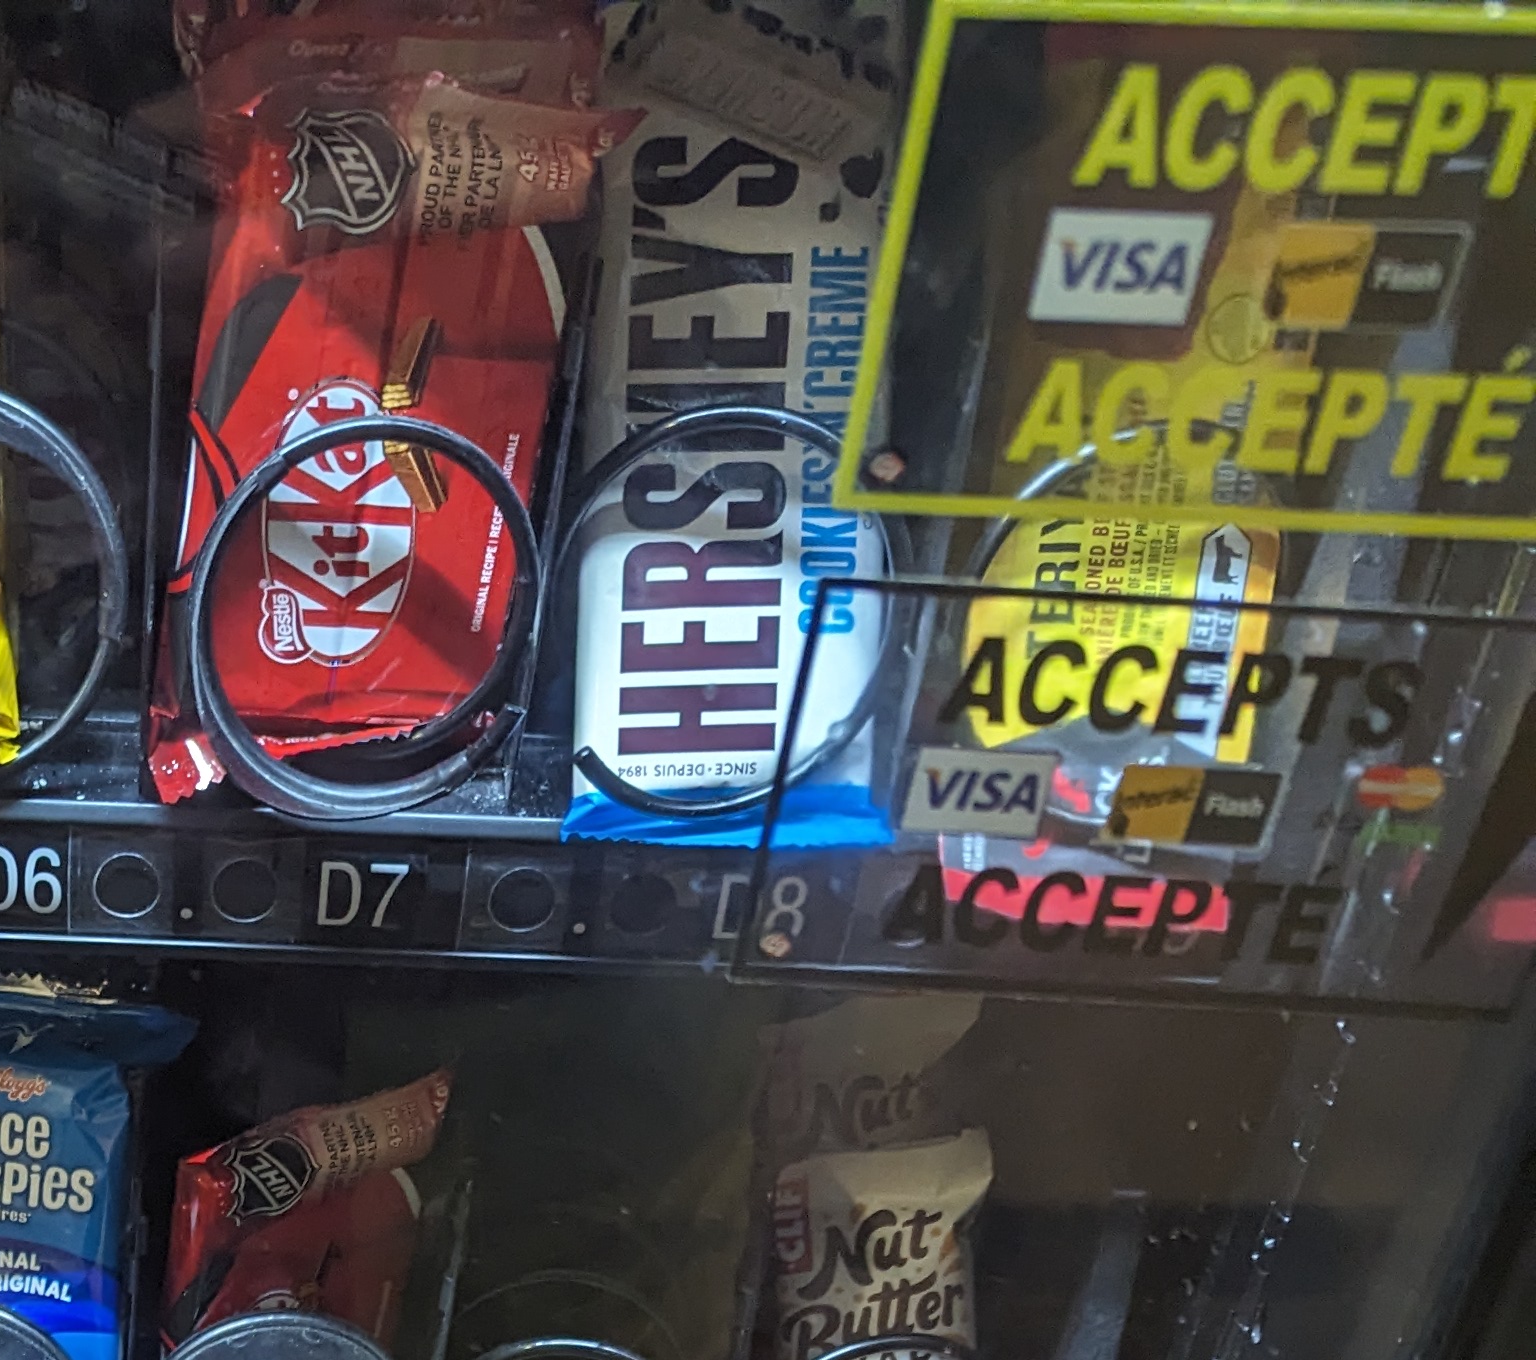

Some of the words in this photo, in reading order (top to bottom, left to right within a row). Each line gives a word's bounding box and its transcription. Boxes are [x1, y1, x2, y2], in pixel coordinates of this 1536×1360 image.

[325, 128, 380, 202] NHL
[1058, 240, 1192, 294] VISA
[480, 547, 498, 584] RECIPE
[272, 594, 298, 652] Nestlé
[939, 637, 1426, 747] ACCEPTS
[617, 763, 649, 778] 1894
[654, 762, 710, 778] DEPUIS
[714, 760, 757, 777] SINCE
[925, 767, 1041, 815] VISA
[317, 863, 410, 929] D7
[251, 1155, 295, 1199] NHL
[776, 1180, 807, 1264] CLIF
[797, 1209, 943, 1300] Nut
